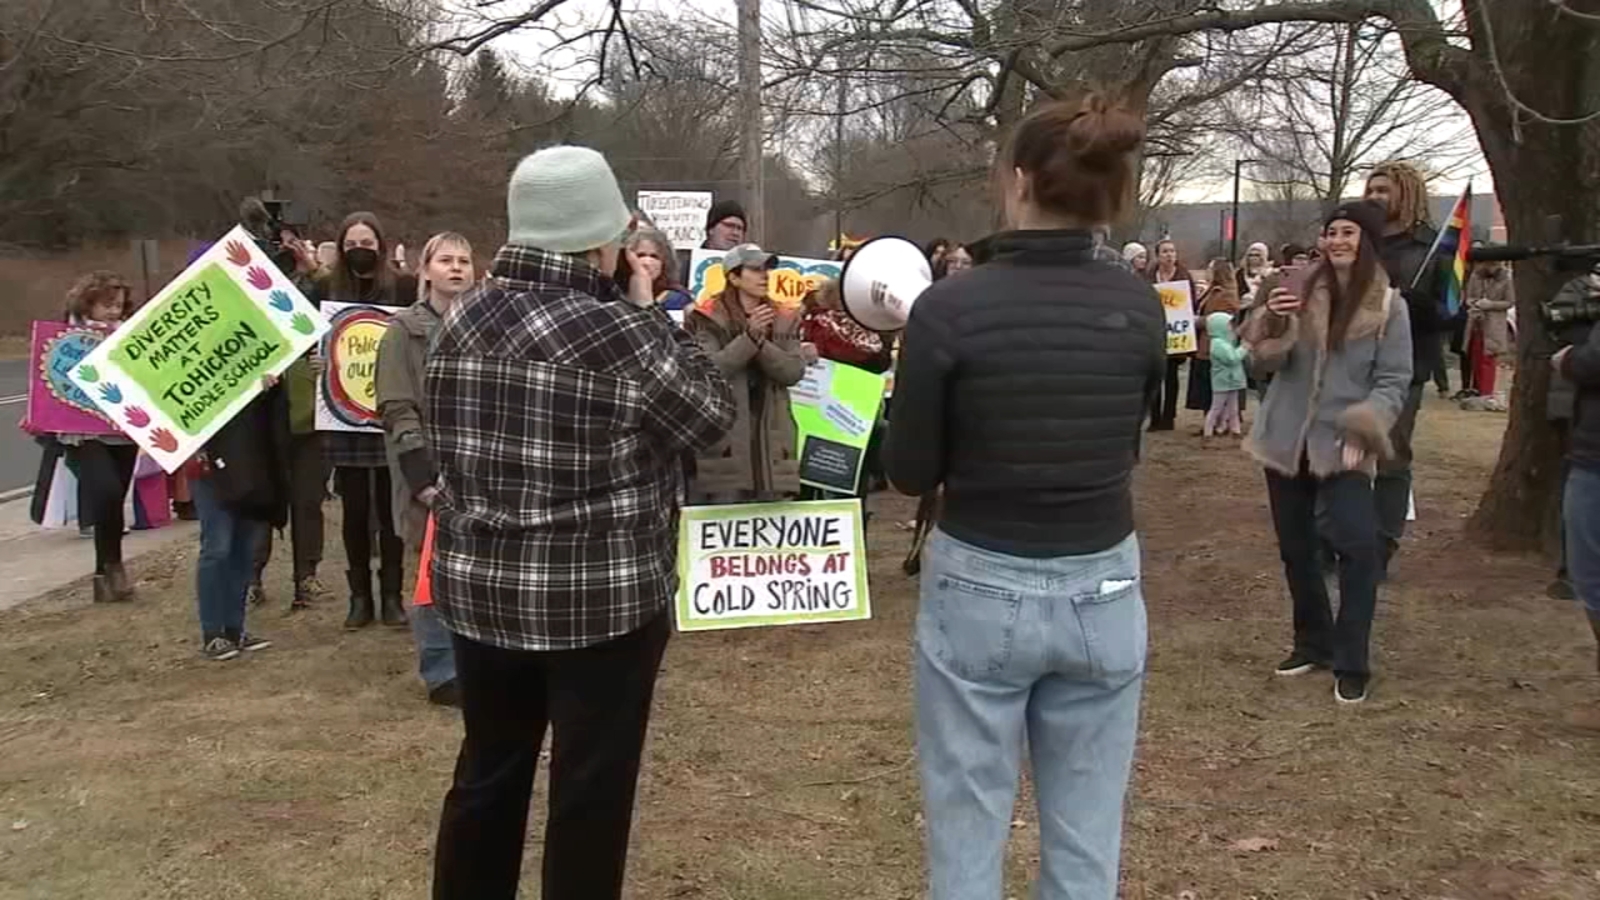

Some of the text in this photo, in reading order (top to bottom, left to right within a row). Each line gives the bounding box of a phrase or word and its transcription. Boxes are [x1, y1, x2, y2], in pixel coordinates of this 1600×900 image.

[124, 281, 212, 361] DIVERSITY
[148, 305, 220, 370] MATTERS
[162, 320, 258, 406] TOHICKON
[180, 341, 203, 369] AT
[179, 340, 280, 428] MIDDLE SCHOOL
[700, 515, 841, 550] EVERYONE
[709, 552, 851, 579] BELONGS AT
[693, 578, 852, 615] COLD SPRING
